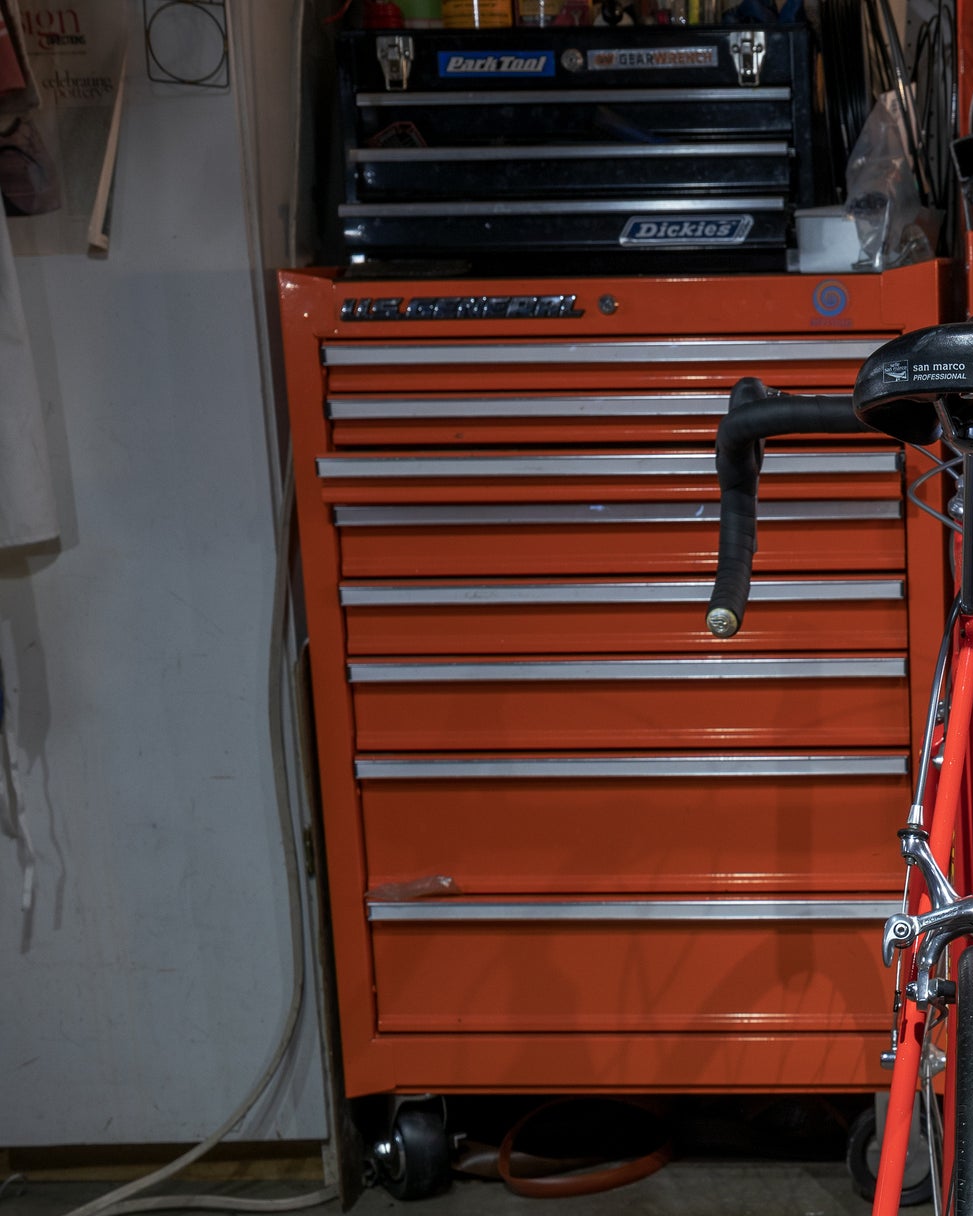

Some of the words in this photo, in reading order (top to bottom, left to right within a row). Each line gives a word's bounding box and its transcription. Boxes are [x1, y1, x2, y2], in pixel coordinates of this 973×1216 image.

[619, 49, 713, 66] GEARWRENCH
[635, 220, 732, 238] Dickies
[912, 363, 930, 372] san
[932, 361, 966, 371] marco
[912, 372, 967, 381] PROFESSIONAL
